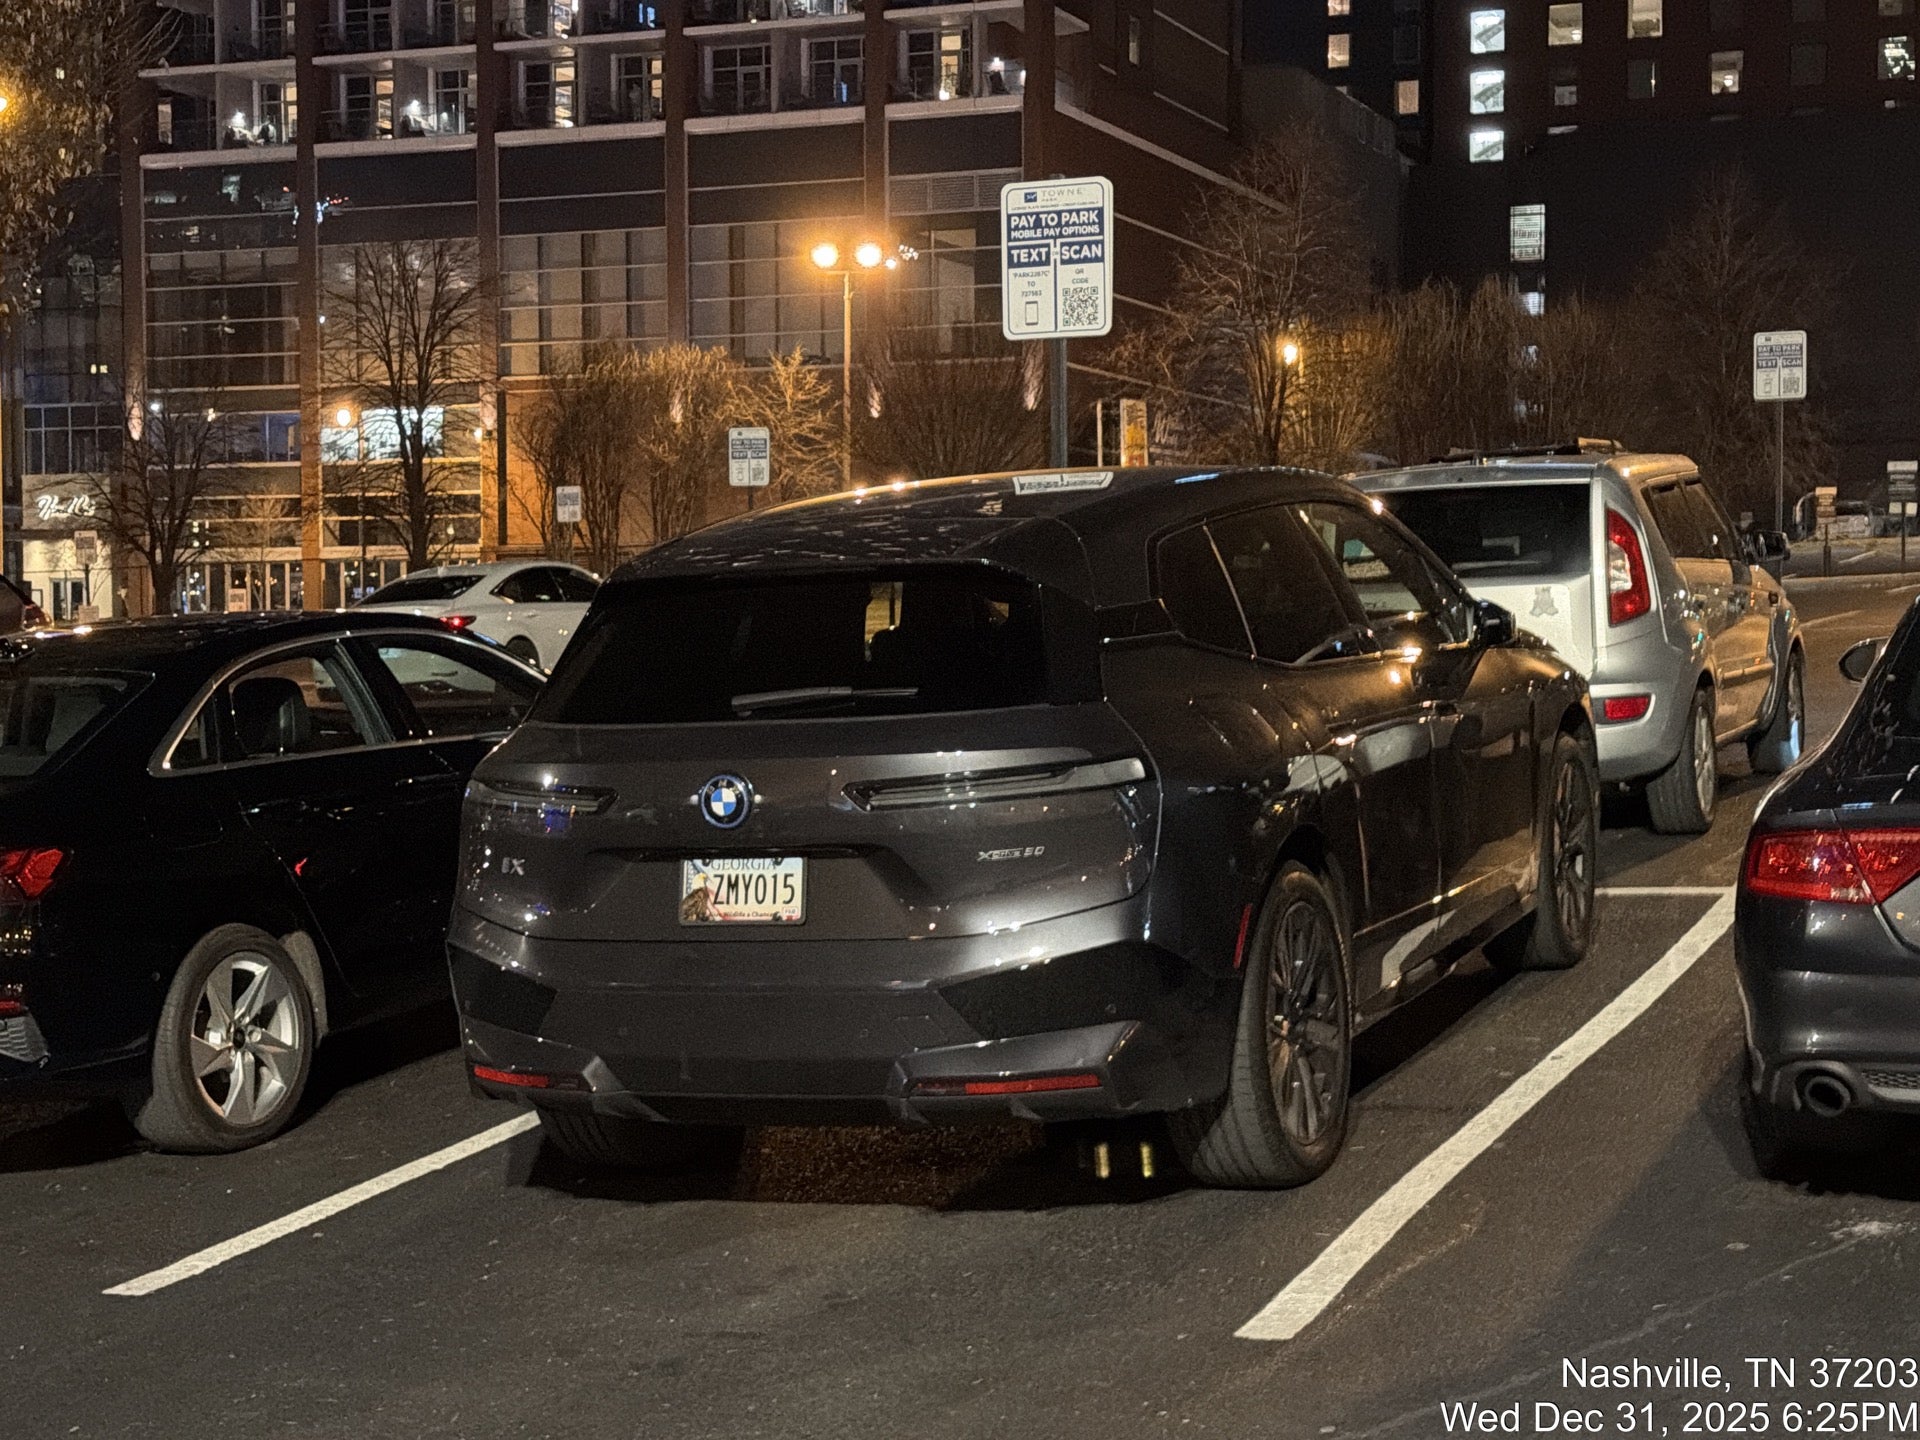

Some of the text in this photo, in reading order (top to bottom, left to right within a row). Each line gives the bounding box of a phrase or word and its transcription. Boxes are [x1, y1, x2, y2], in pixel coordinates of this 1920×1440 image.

[1041, 187, 1083, 197] TOWNE
[1010, 210, 1099, 229] PAY TO PARK
[1011, 224, 1100, 239] MOBILE PAY OPTIONS
[1011, 247, 1048, 263] TEXT
[1061, 243, 1102, 260] SCAN
[711, 858, 777, 871] GEORGIA
[713, 874, 796, 906] ZMY015
